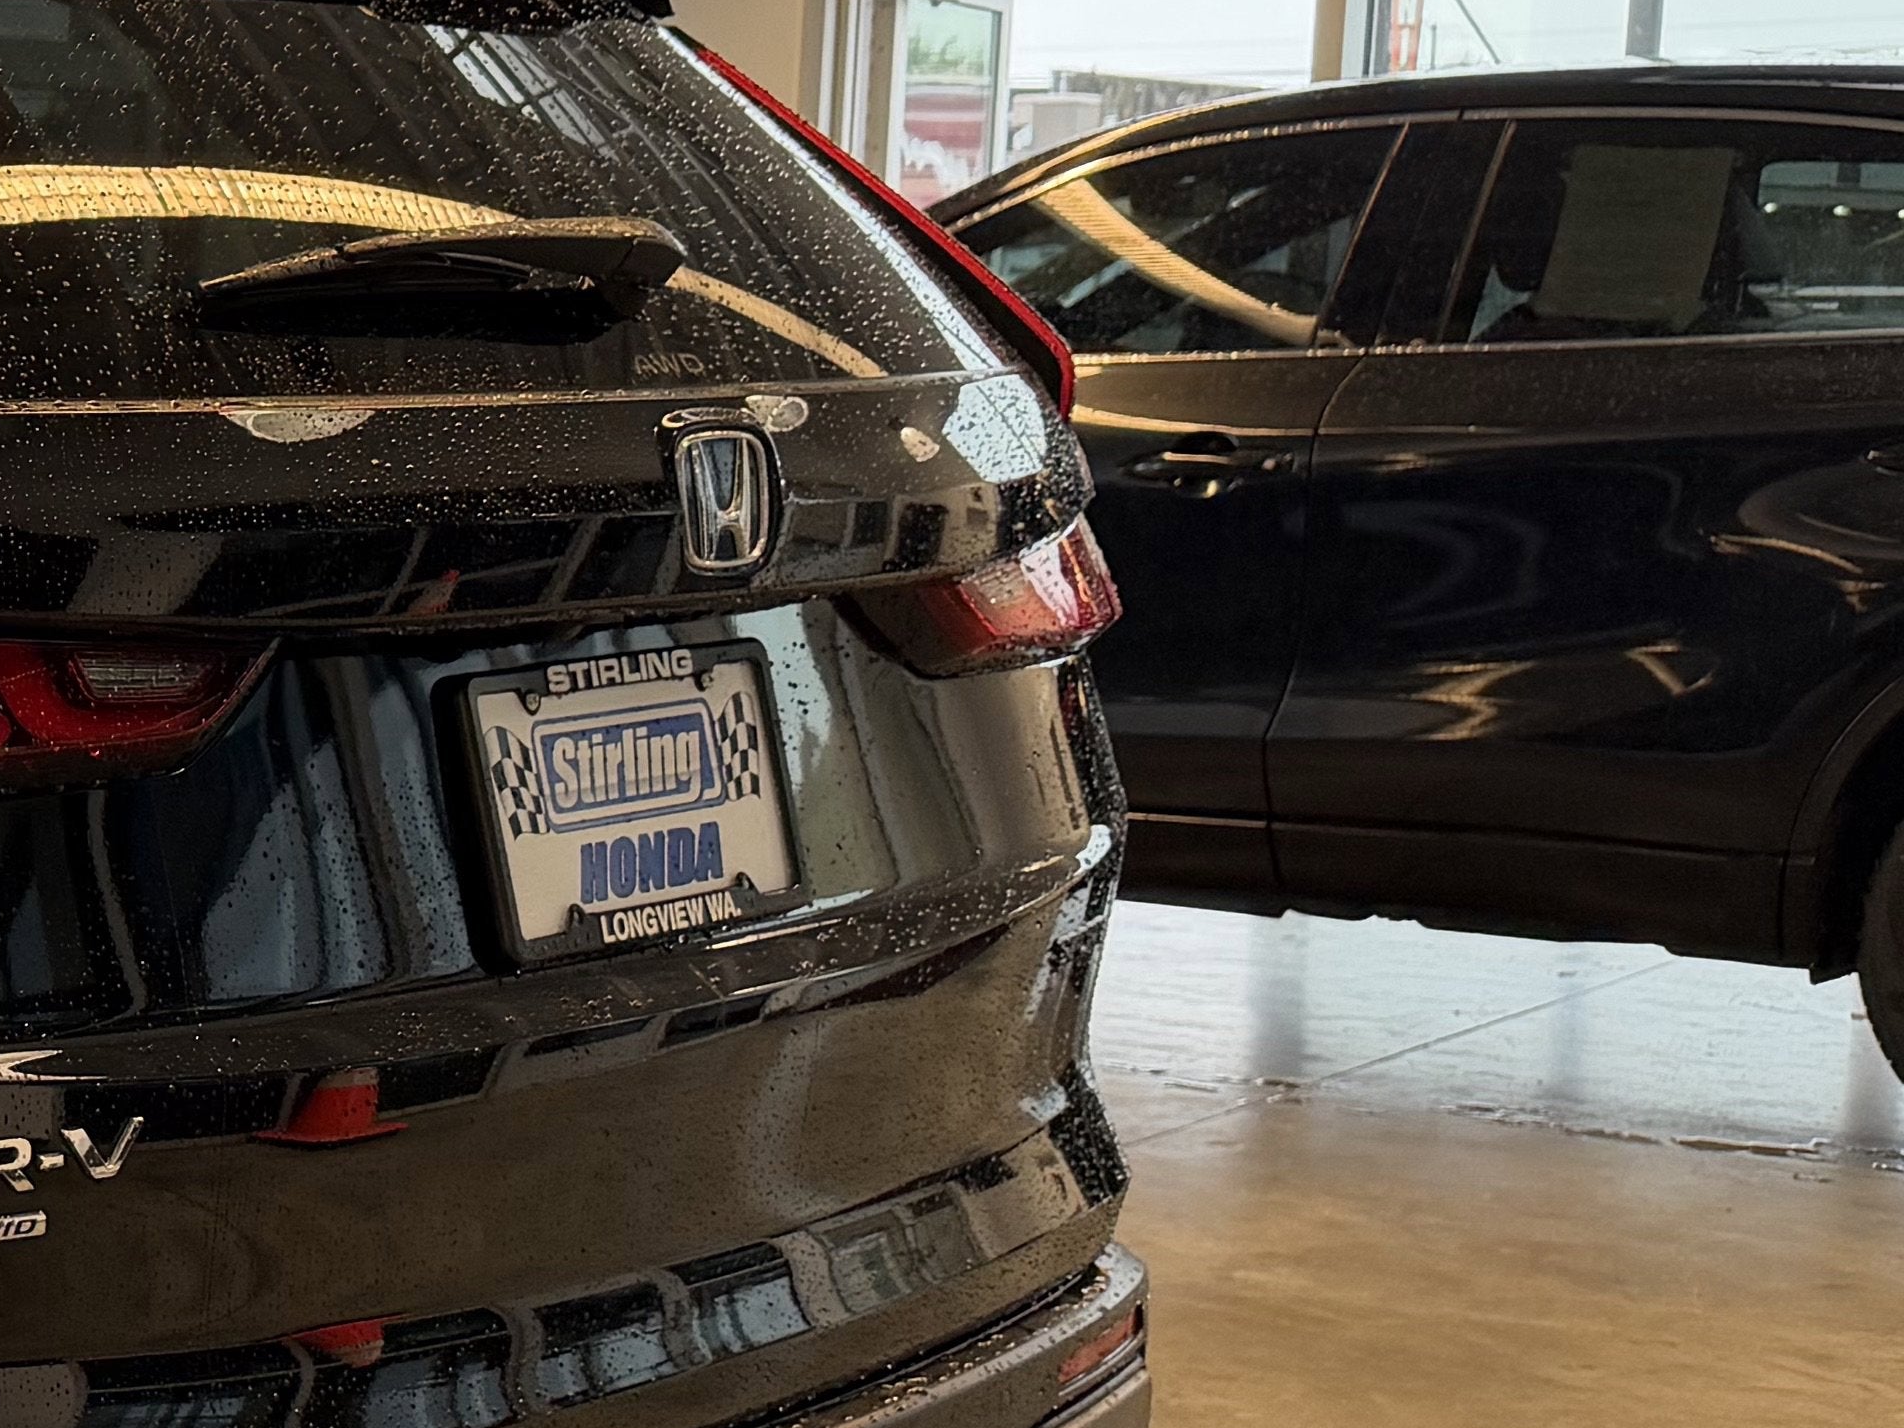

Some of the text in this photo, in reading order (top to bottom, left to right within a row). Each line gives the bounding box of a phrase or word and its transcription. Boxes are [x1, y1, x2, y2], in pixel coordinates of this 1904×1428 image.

[634, 353, 705, 378] AWD
[546, 648, 694, 693] STIRLING
[552, 726, 701, 809] Stirling
[580, 821, 724, 905] HONDA
[600, 891, 742, 944] LONGVIEW WA.
